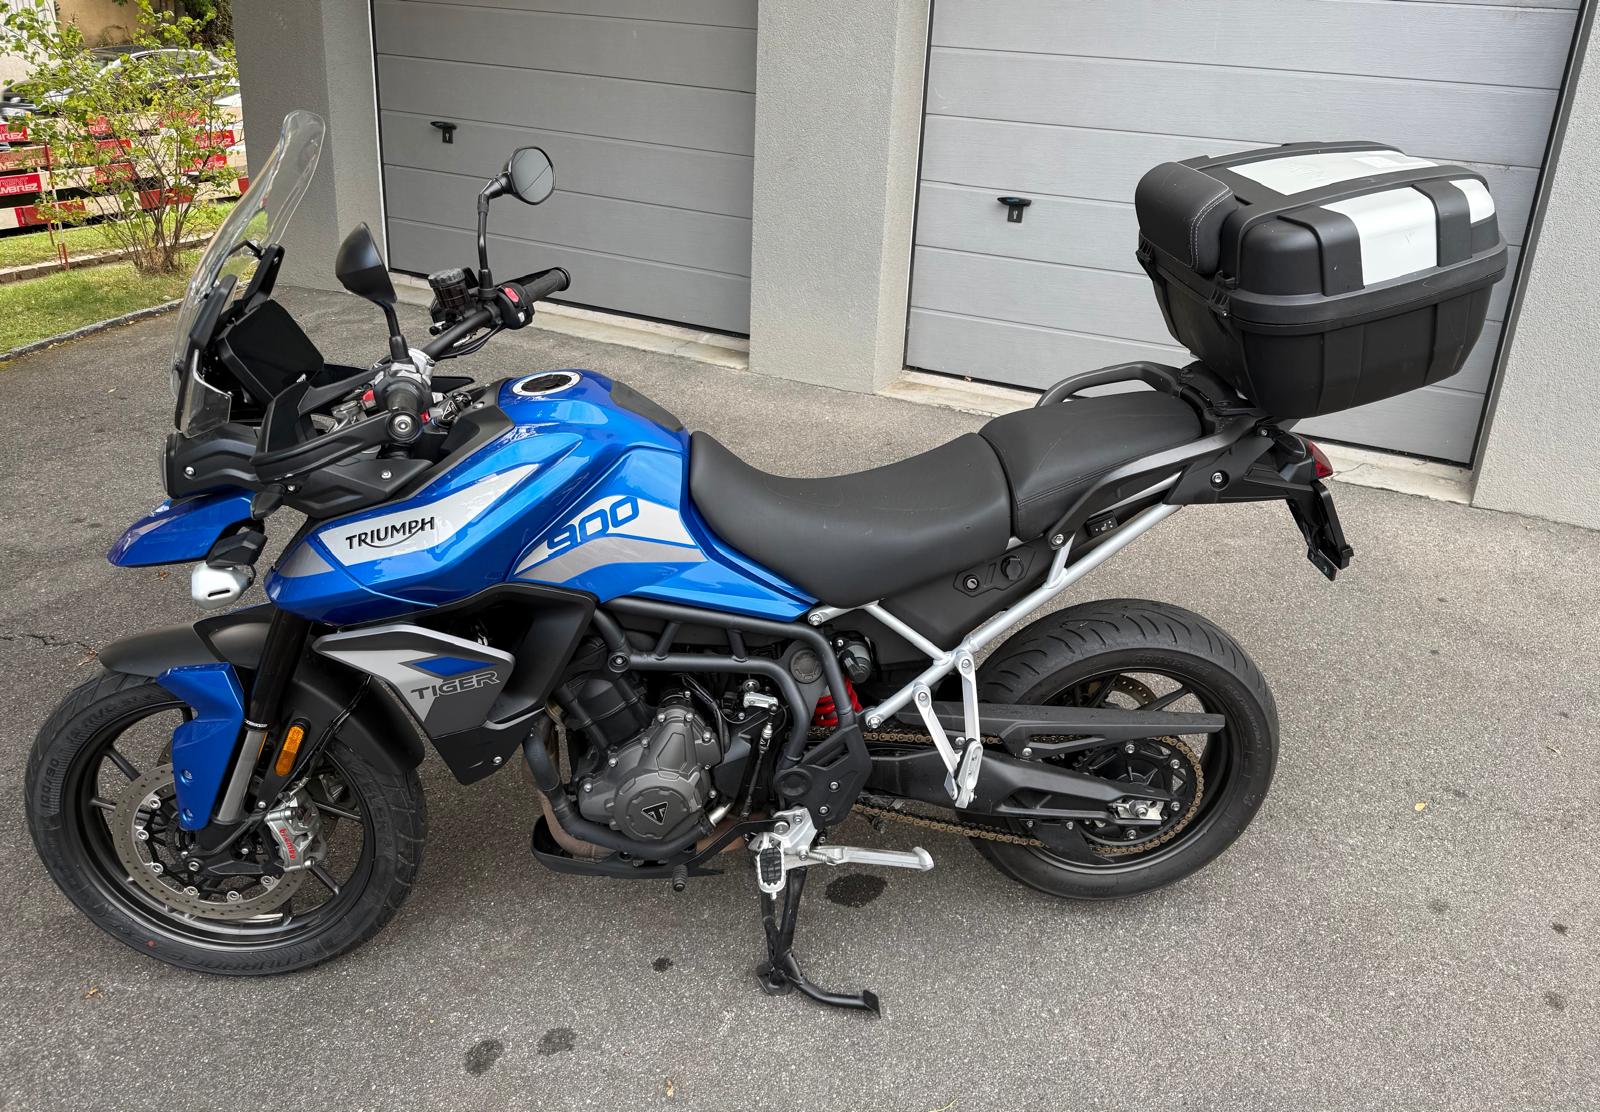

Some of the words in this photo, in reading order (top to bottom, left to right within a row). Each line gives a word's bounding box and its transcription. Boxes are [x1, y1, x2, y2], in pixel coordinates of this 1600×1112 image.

[345, 516, 435, 550] TRIUMPH
[546, 495, 640, 558] 900
[410, 670, 501, 700] TIGER
